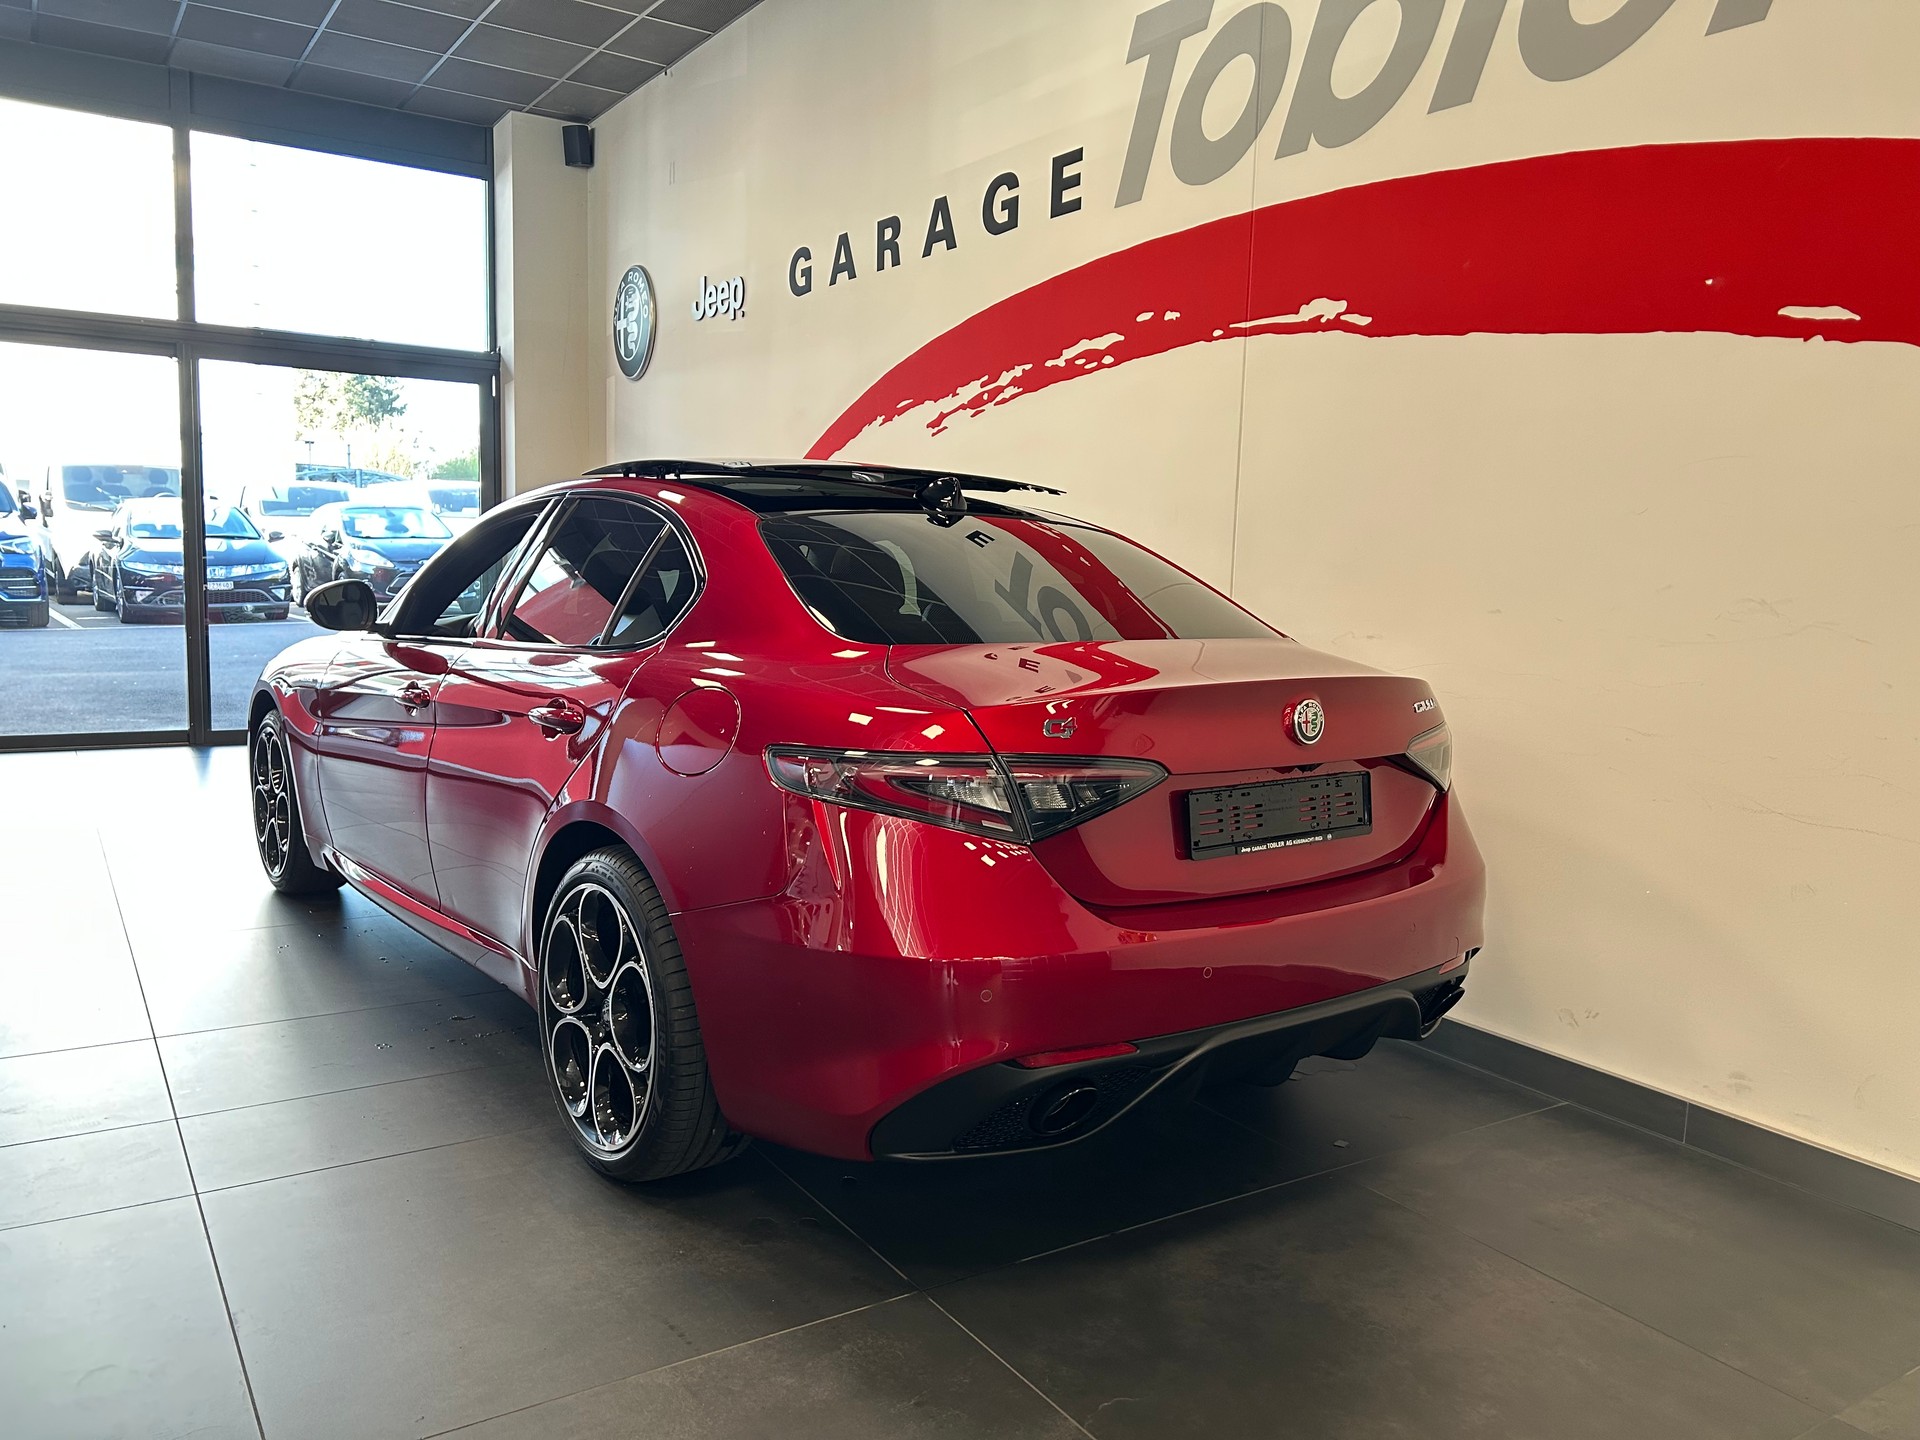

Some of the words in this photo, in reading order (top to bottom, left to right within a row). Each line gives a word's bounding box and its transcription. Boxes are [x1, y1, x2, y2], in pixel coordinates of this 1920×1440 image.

[788, 146, 1085, 297] GARAGE
[1113, 0, 1778, 209] Tob
[627, 271, 649, 319] ROMEO
[691, 275, 746, 321] Jeep
[1043, 717, 1078, 738] Q4
[1267, 841, 1285, 849] TOBLER
